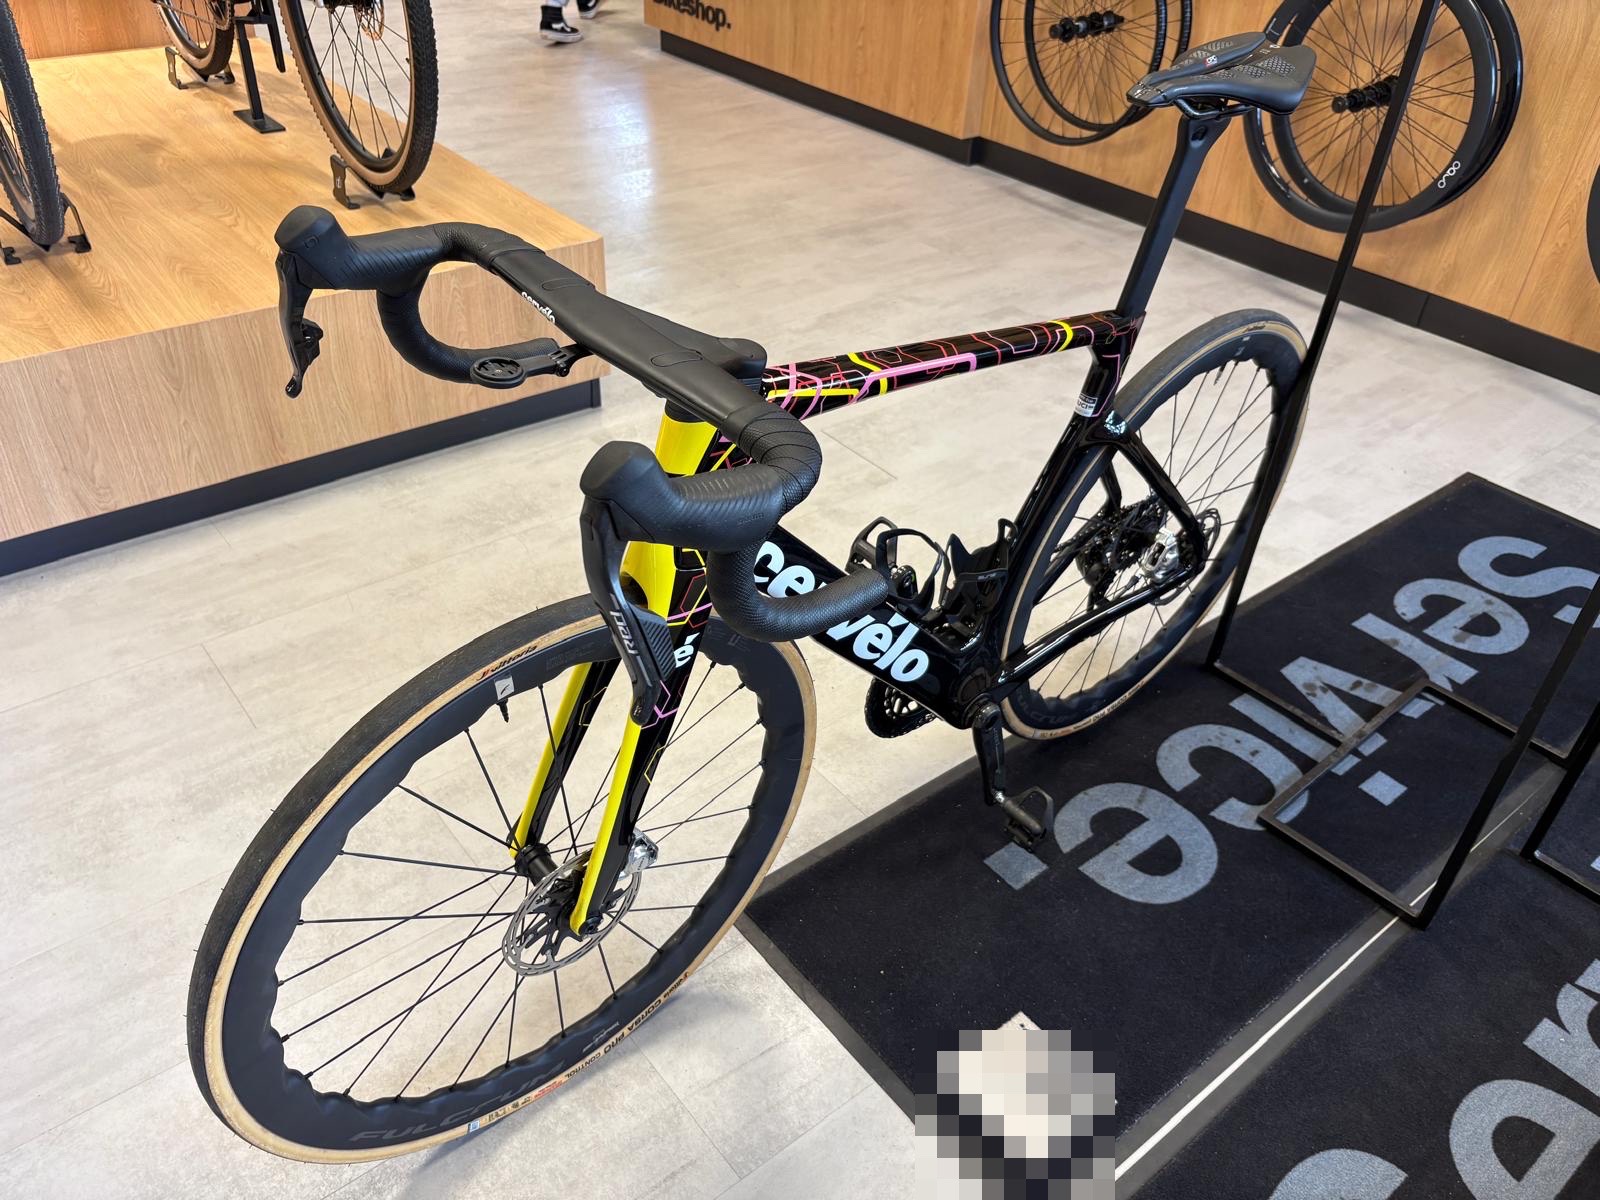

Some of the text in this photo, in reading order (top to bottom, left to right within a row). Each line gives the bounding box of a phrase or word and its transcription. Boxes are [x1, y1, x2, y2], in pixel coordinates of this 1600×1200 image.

[652, 0, 732, 32] eshop.
[753, 541, 930, 682] cevélo
[627, 999, 662, 1032] CORSA
[603, 1031, 625, 1055] PRO
[565, 1051, 601, 1079] CONTROL
